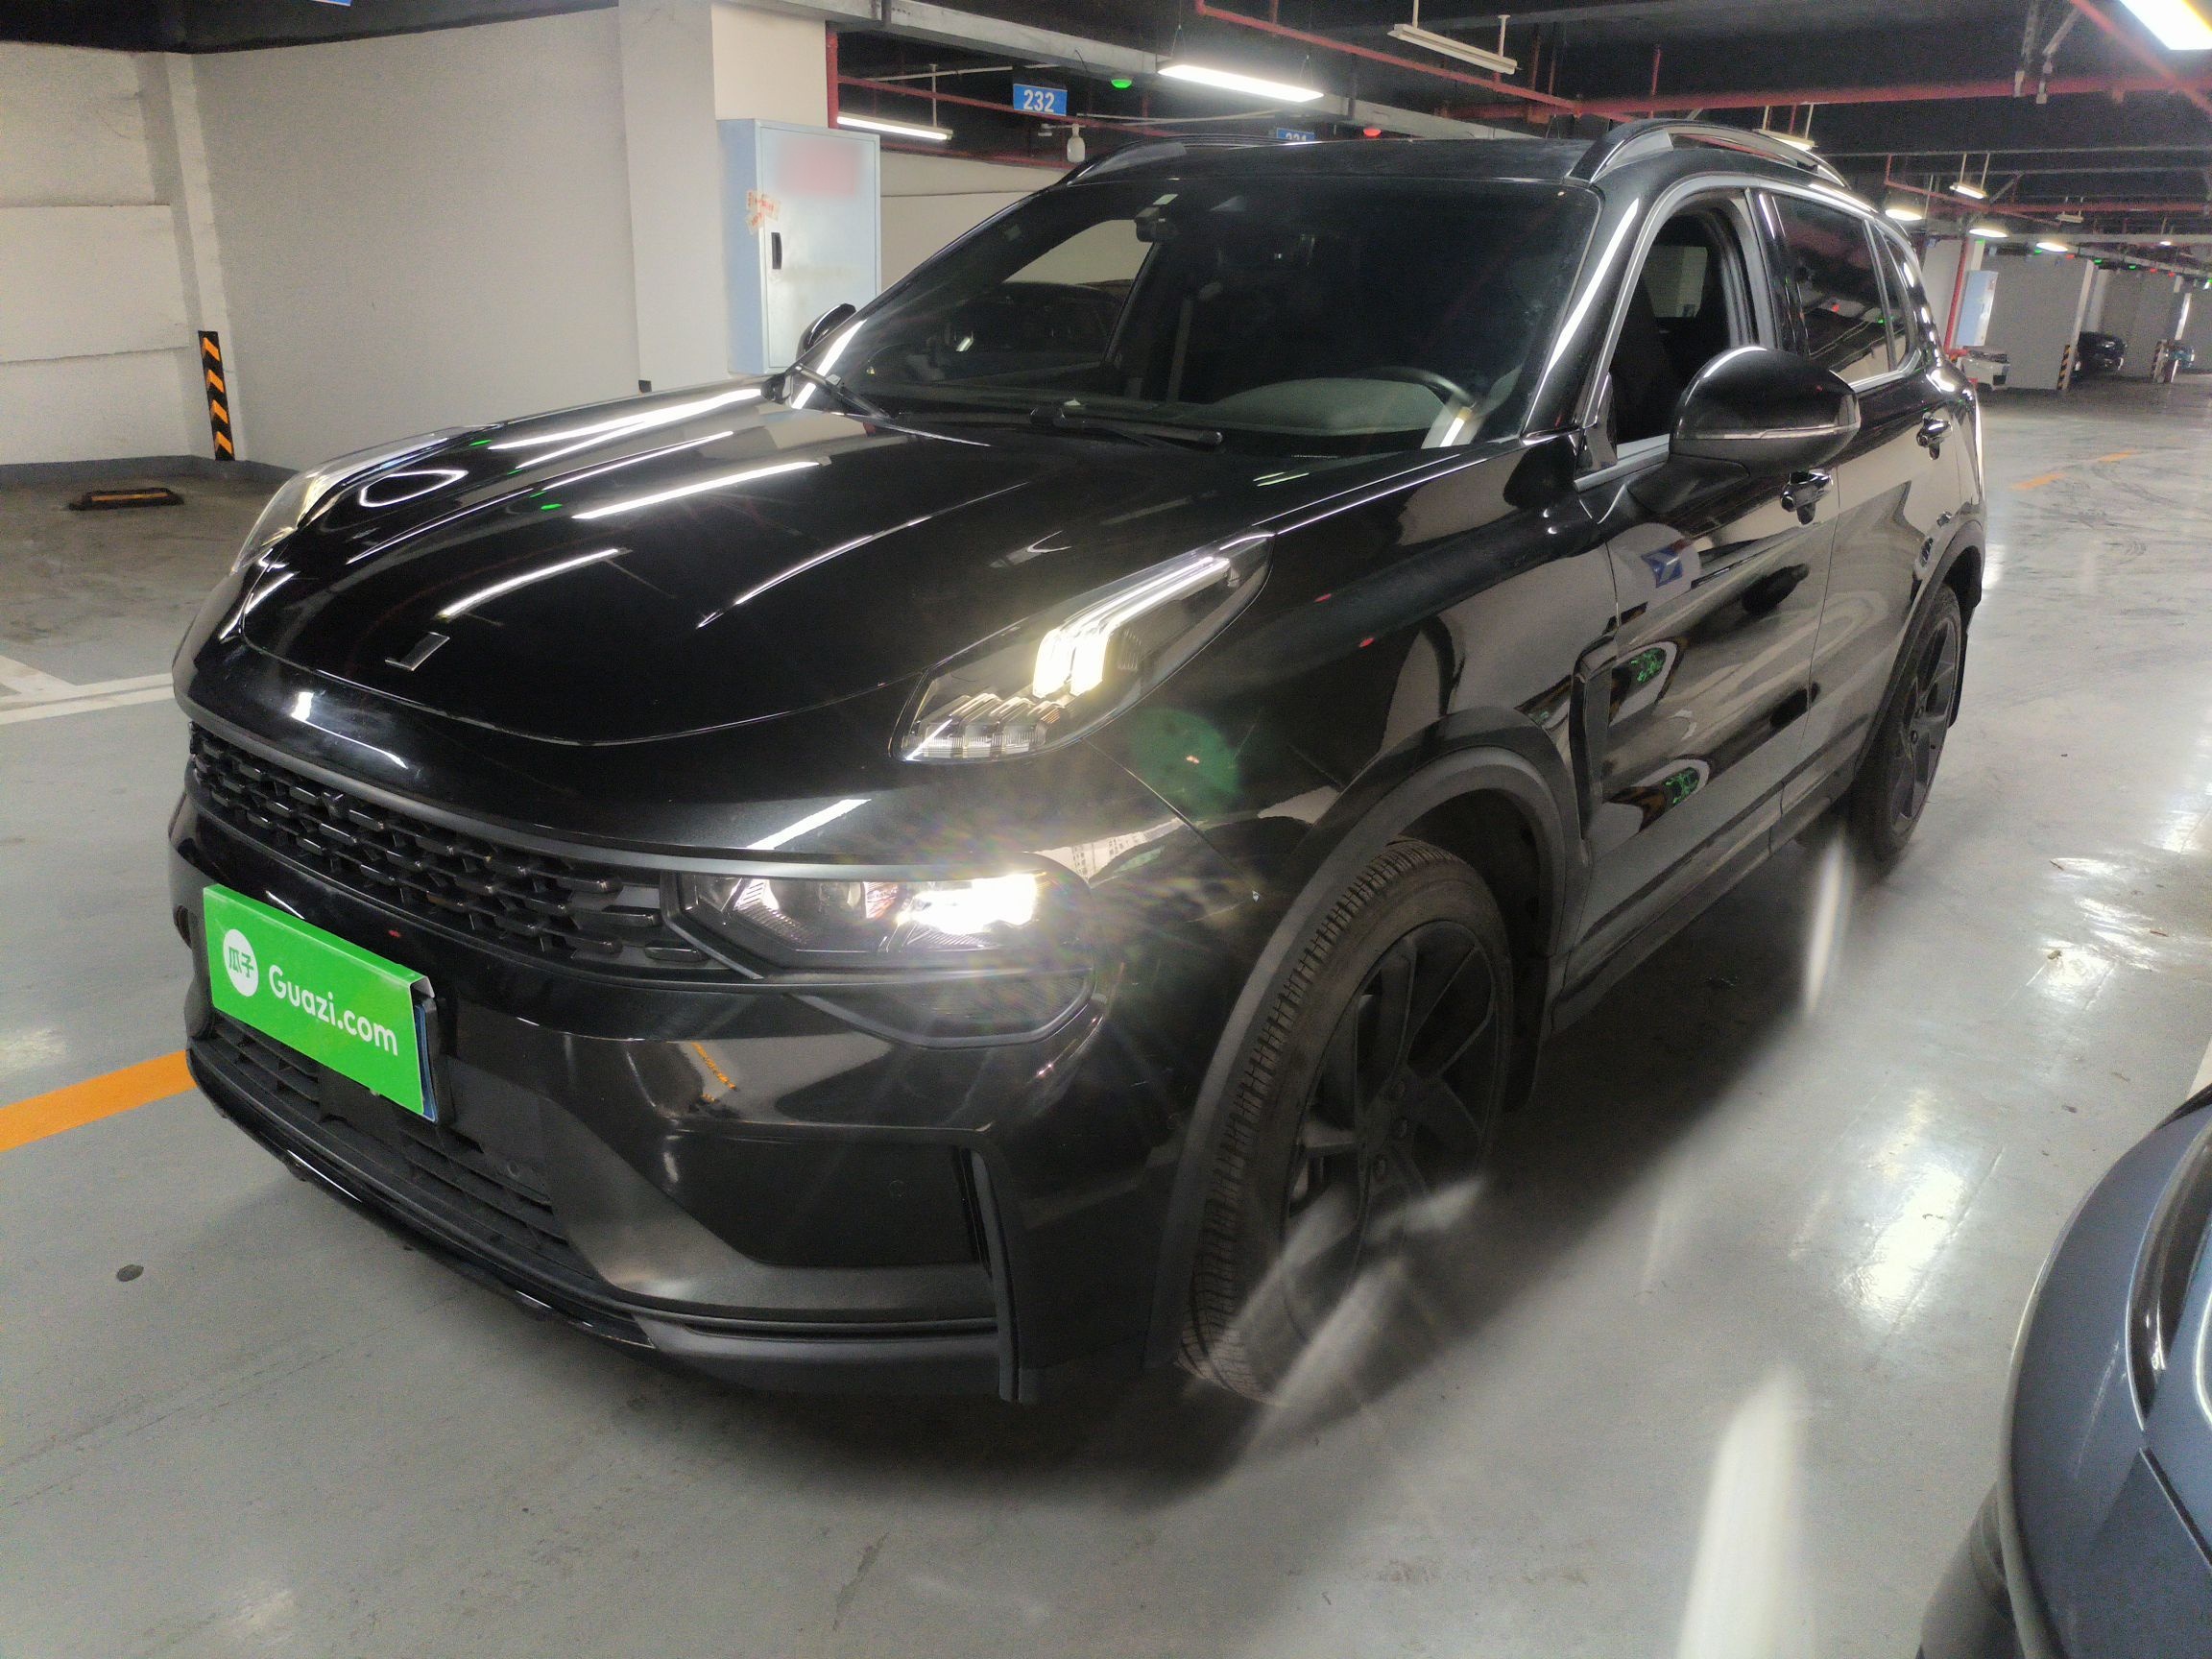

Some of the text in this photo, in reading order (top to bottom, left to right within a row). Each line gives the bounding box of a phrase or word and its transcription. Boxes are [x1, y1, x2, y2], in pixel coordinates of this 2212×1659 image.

[1023, 89, 1055, 113] 232
[228, 947, 254, 978] 瓜子
[269, 964, 398, 1056] Guazi.com
